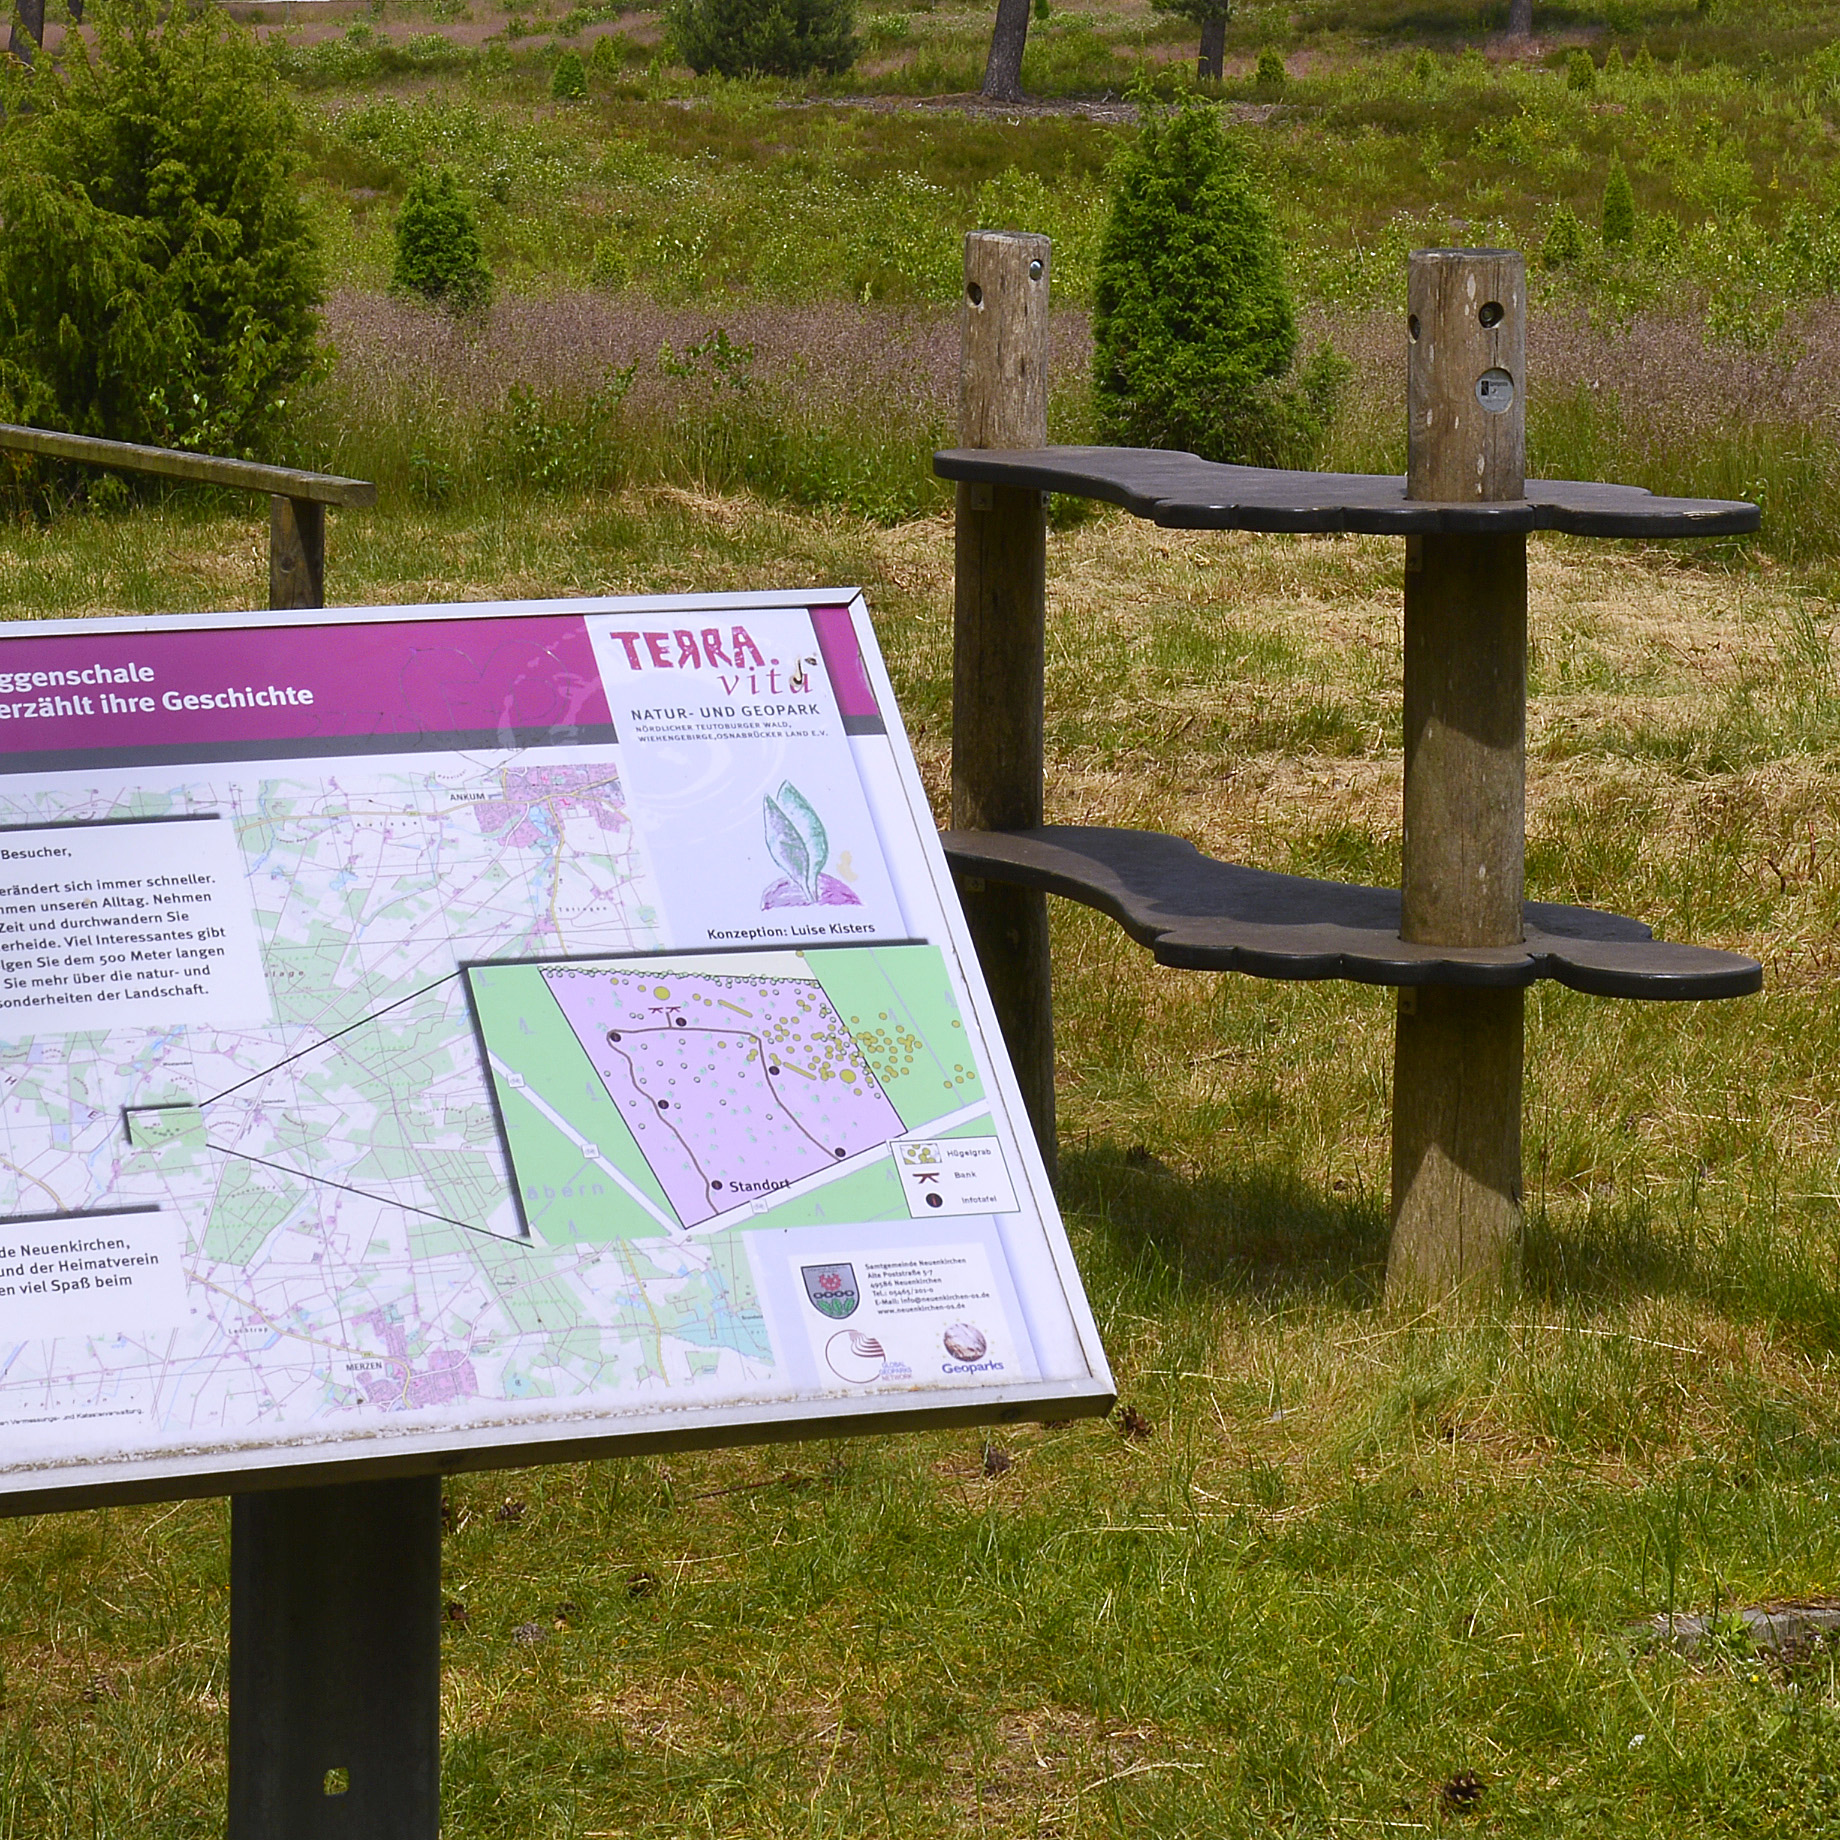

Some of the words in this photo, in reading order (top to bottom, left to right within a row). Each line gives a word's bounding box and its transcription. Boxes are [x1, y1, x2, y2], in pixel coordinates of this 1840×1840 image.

[100, 693, 155, 714] ihre
[162, 685, 314, 711] Geschichte
[631, 708, 694, 721] NATUR-
[700, 706, 736, 719] UND
[741, 704, 821, 717] GEOPARK
[635, 723, 693, 733] NÖRDLICHER
[696, 722, 761, 731] TEUTOBURGER
[763, 721, 792, 729] WALD,
[785, 730, 809, 738] LAND
[811, 730, 829, 738] E.V.
[449, 791, 487, 802] ANKUM
[1, 847, 72, 860] Besucher,
[64, 880, 93, 892] sich
[97, 879, 142, 890] immer
[146, 874, 215, 887] schneller.
[41, 901, 98, 912] unseren
[102, 896, 149, 908] Alltag.
[153, 893, 211, 904] Nehmen
[29, 919, 56, 931] und
[60, 914, 163, 929] durchwandern
[167, 911, 189, 922] Sie
[64, 935, 93, 947] Viel
[96, 931, 193, 945] Interessantes
[197, 927, 226, 941] gibt
[707, 926, 788, 940] Konzeption:
[791, 925, 826, 936] Luise
[829, 923, 876, 934] Kisters
[36, 956, 60, 968] Sie
[64, 955, 95, 966] dem
[100, 954, 126, 966] 500
[131, 950, 172, 961] Meter
[176, 948, 225, 959] langen
[4, 977, 27, 989] Sie
[31, 975, 68, 987] mehr
[73, 973, 105, 984] über
[110, 970, 132, 981] die
[137, 969, 179, 979] natur-
[184, 964, 211, 977] und
[97, 990, 120, 1001] der
[124, 984, 209, 999] Landschaft.
[947, 1149, 992, 1158] Hügelgrab
[954, 1171, 977, 1179] Bank
[729, 1178, 791, 1193] Standort
[962, 1195, 997, 1204] Infotafel
[20, 1238, 130, 1256] Neuenkirchen,
[30, 1262, 54, 1274] der
[58, 1253, 159, 1272] Heimatverein
[865, 1261, 917, 1270] Samtgemeinde
[19, 1280, 47, 1294] viel
[51, 1277, 91, 1294] Spaß
[95, 1274, 132, 1288] beim
[346, 1361, 382, 1371] MERZEN
[942, 1360, 1004, 1375] Geoparks
